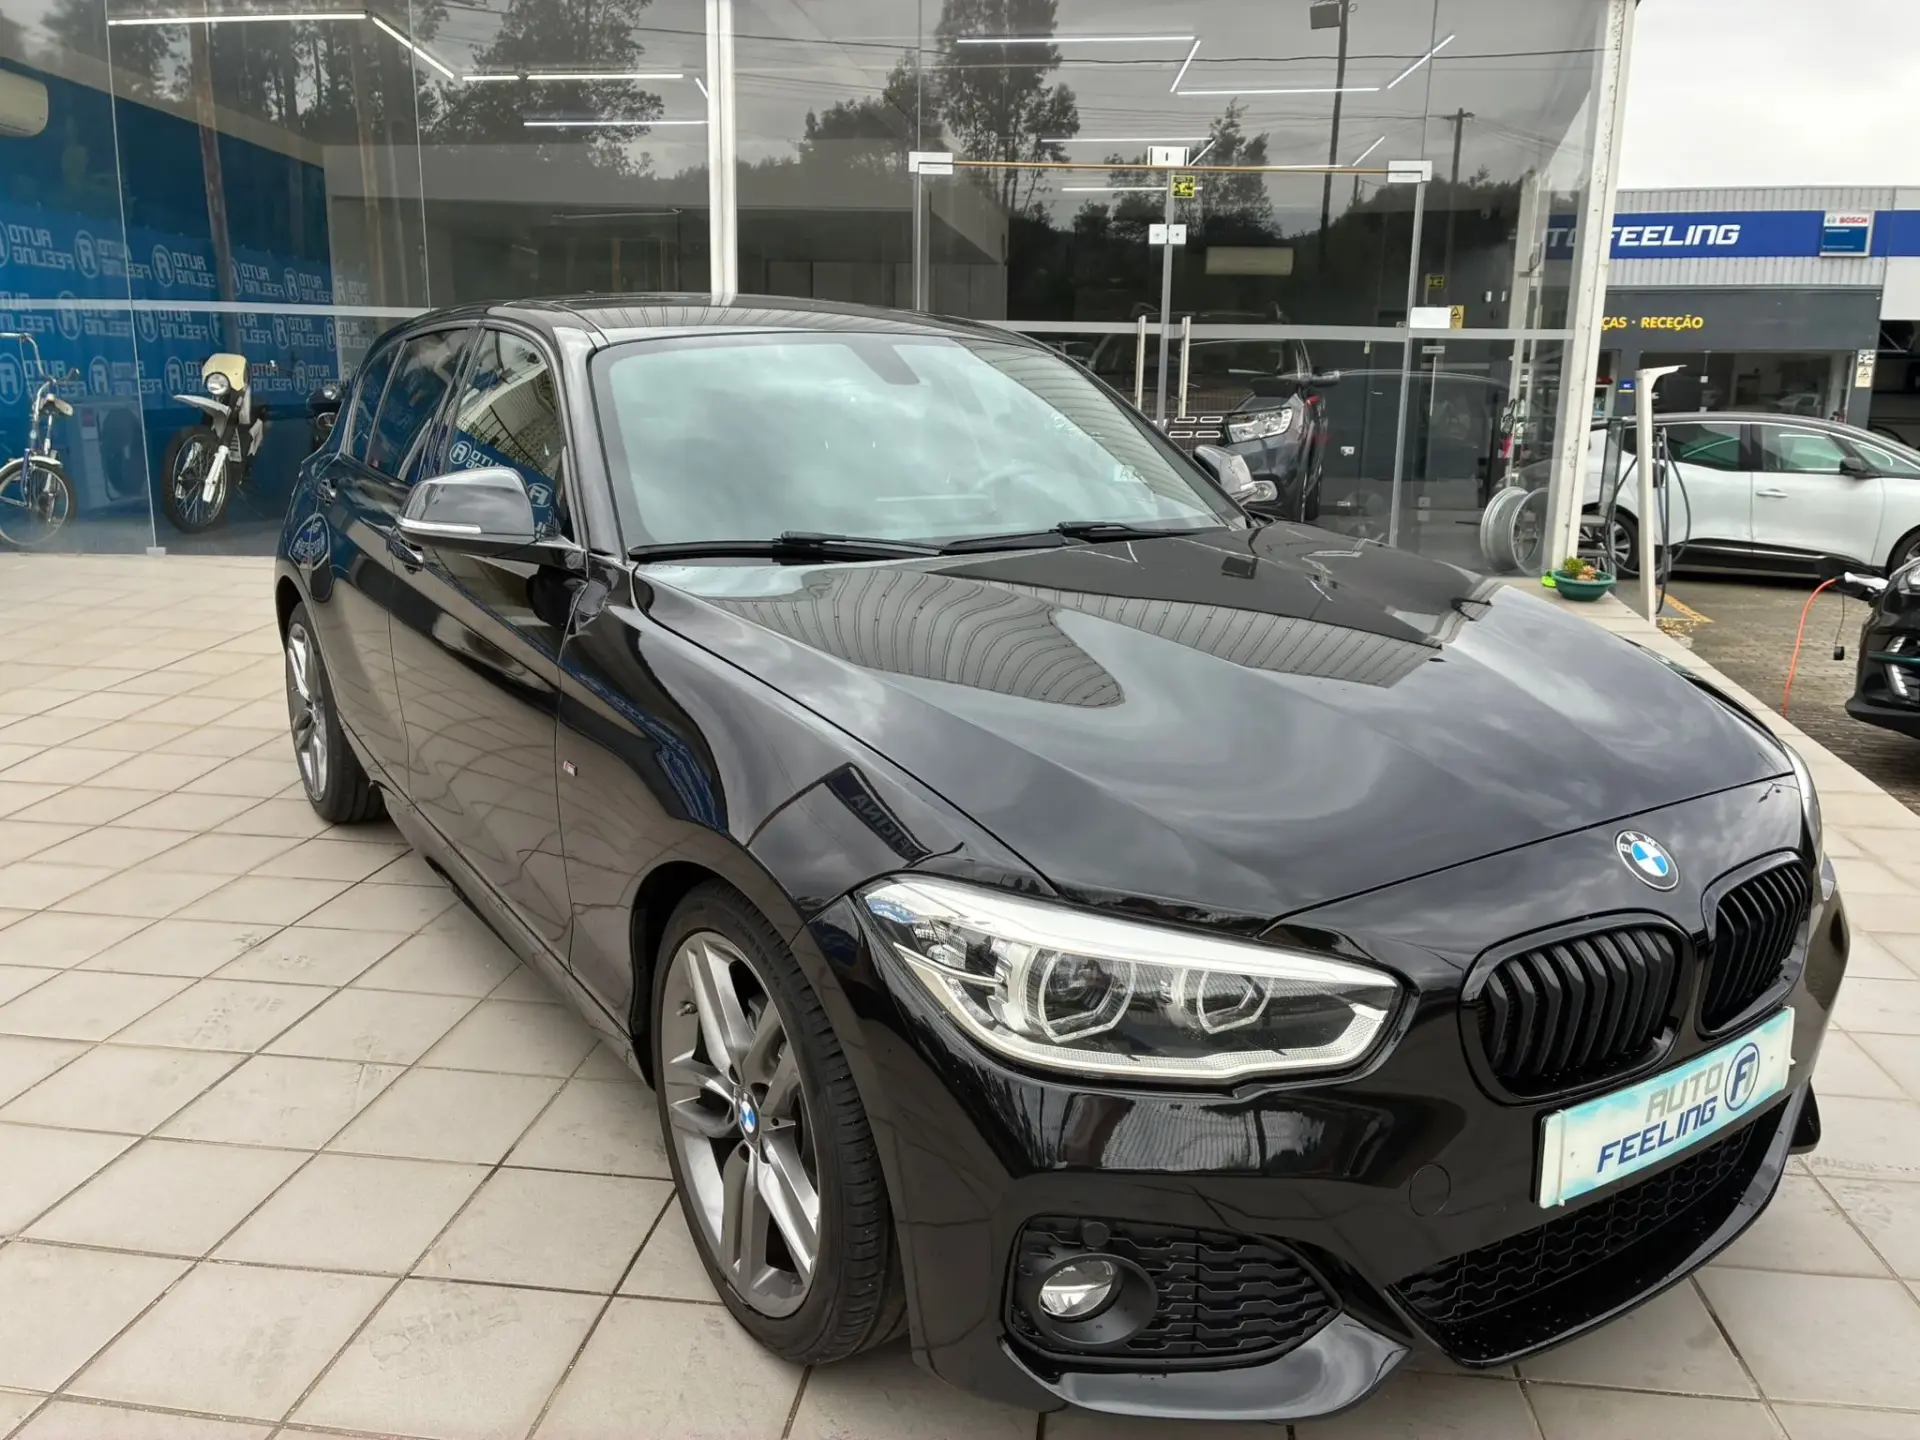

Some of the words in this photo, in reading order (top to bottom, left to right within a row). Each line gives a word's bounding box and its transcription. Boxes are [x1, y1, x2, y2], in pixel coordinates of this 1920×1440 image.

[1839, 216, 1868, 224] BOSCH
[1640, 314, 1704, 331] RECEÇÃO
[1645, 1060, 1725, 1124] AUTO
[1596, 1095, 1719, 1174] FEELING
